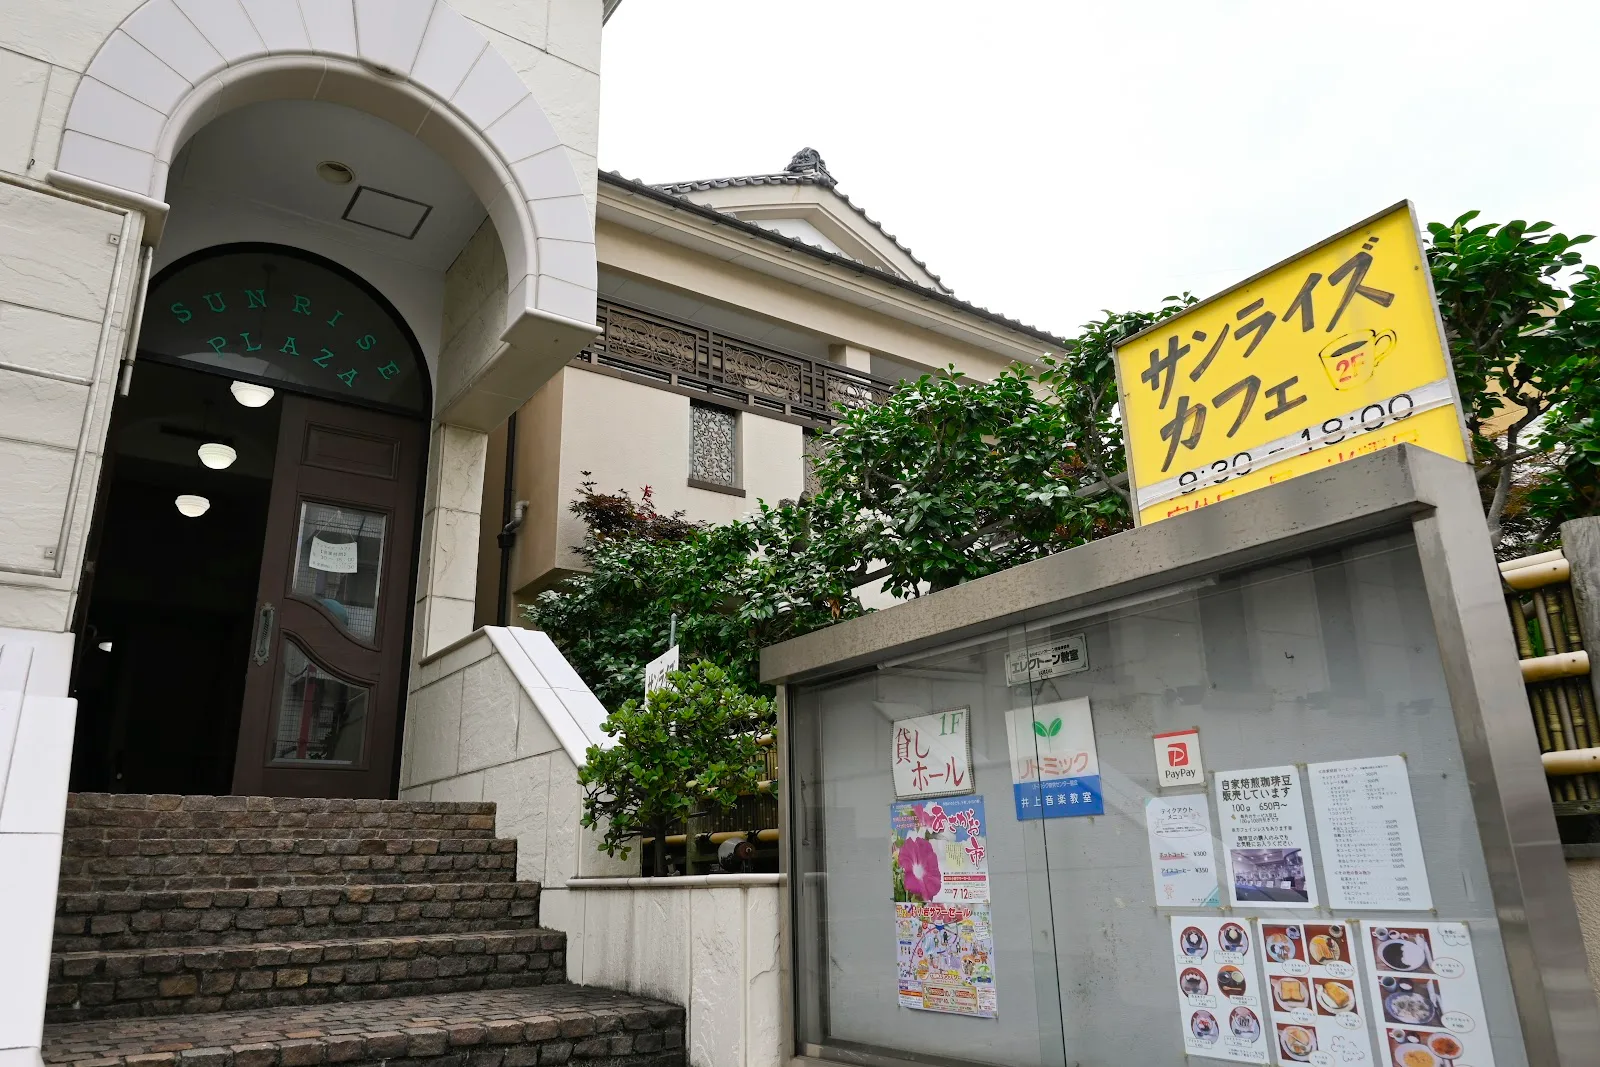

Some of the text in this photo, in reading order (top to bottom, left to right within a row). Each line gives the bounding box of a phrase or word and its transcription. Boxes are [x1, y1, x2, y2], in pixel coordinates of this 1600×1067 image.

[171, 290, 400, 380] SUNRISE
[1141, 237, 1395, 409] サンライズ
[206, 332, 357, 387] PLAZA
[1159, 374, 1307, 473] カフェ
[1179, 452, 1252, 494] 9:30
[1011, 648, 1079, 674] エレクトーン教室
[938, 711, 963, 736] 1F
[895, 727, 930, 765] 貸し
[911, 756, 965, 792] ホール
[1164, 768, 1196, 780] PayPay
[1221, 774, 1293, 791] 自家焙煎珈琲豆
[1021, 791, 1093, 809] 井上音楽教室
[1222, 787, 1291, 802] 販売しています
[1232, 803, 1251, 812] 100g
